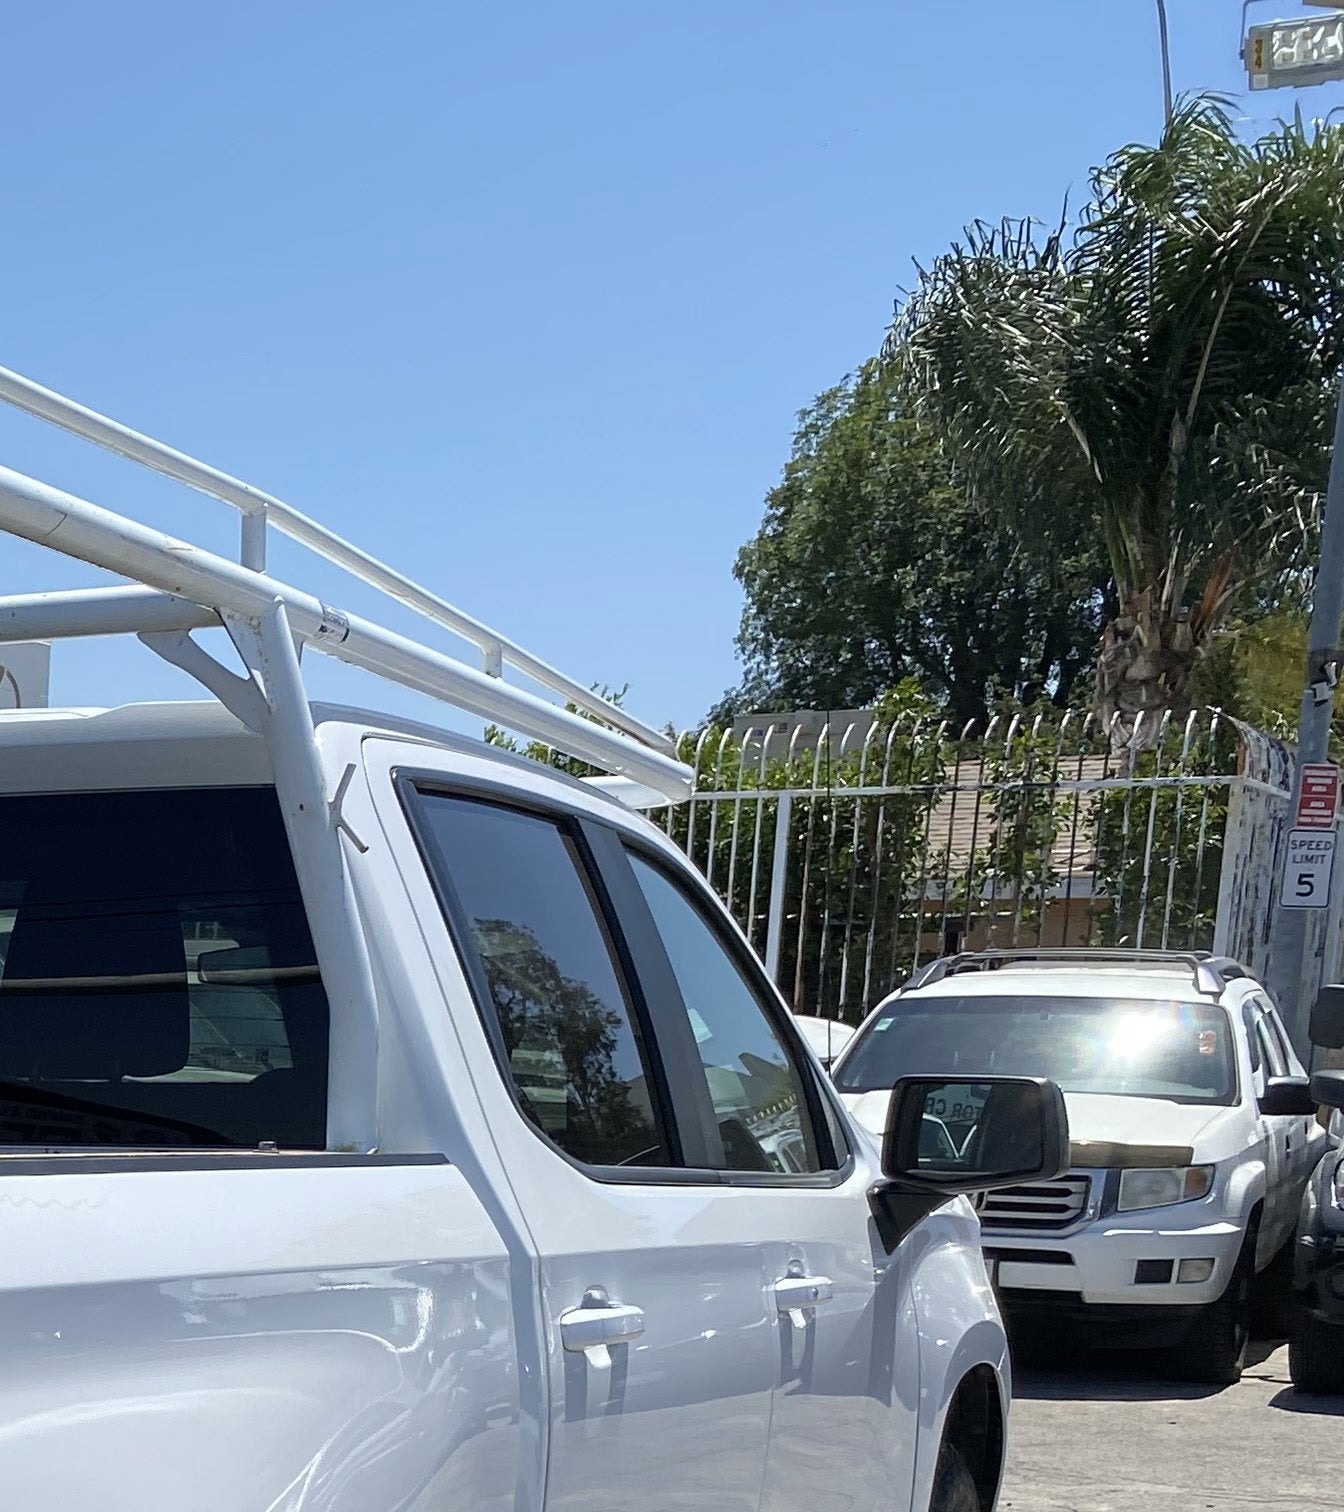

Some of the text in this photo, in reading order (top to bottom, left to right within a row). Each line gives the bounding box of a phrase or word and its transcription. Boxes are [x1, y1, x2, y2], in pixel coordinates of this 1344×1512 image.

[1290, 839, 1332, 852] SPEED
[1291, 853, 1326, 866] LIMIT
[1295, 873, 1315, 897] 5
